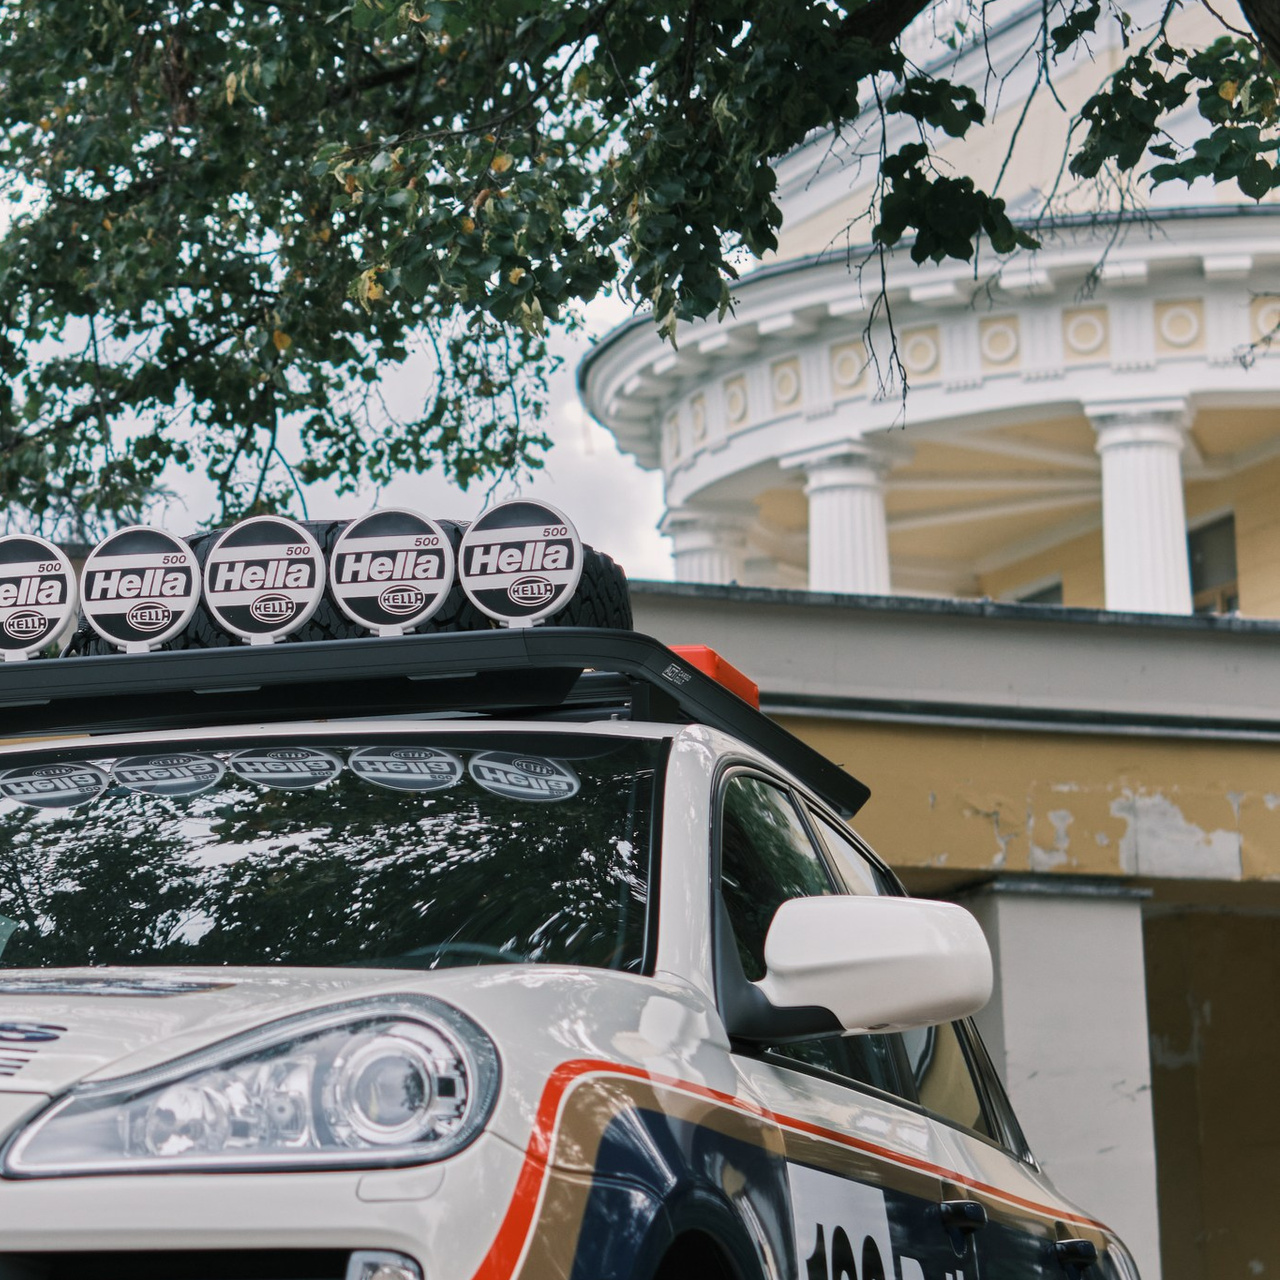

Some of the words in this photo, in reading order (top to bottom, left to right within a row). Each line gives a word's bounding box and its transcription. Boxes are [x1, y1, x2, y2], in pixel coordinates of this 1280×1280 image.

[542, 527, 568, 537] 500
[414, 536, 439, 547] 500
[286, 546, 311, 556] 500
[162, 555, 187, 565] 500
[469, 541, 570, 576] Hella
[38, 562, 62, 573] 500
[340, 551, 440, 583] Hella
[214, 559, 311, 591] Hella
[90, 569, 187, 600] Hella
[512, 584, 554, 597] HELLA
[382, 592, 424, 606] HELLA
[255, 601, 295, 614] HELLA
[131, 609, 171, 623] HELLA
[7, 618, 47, 631] HELLA
